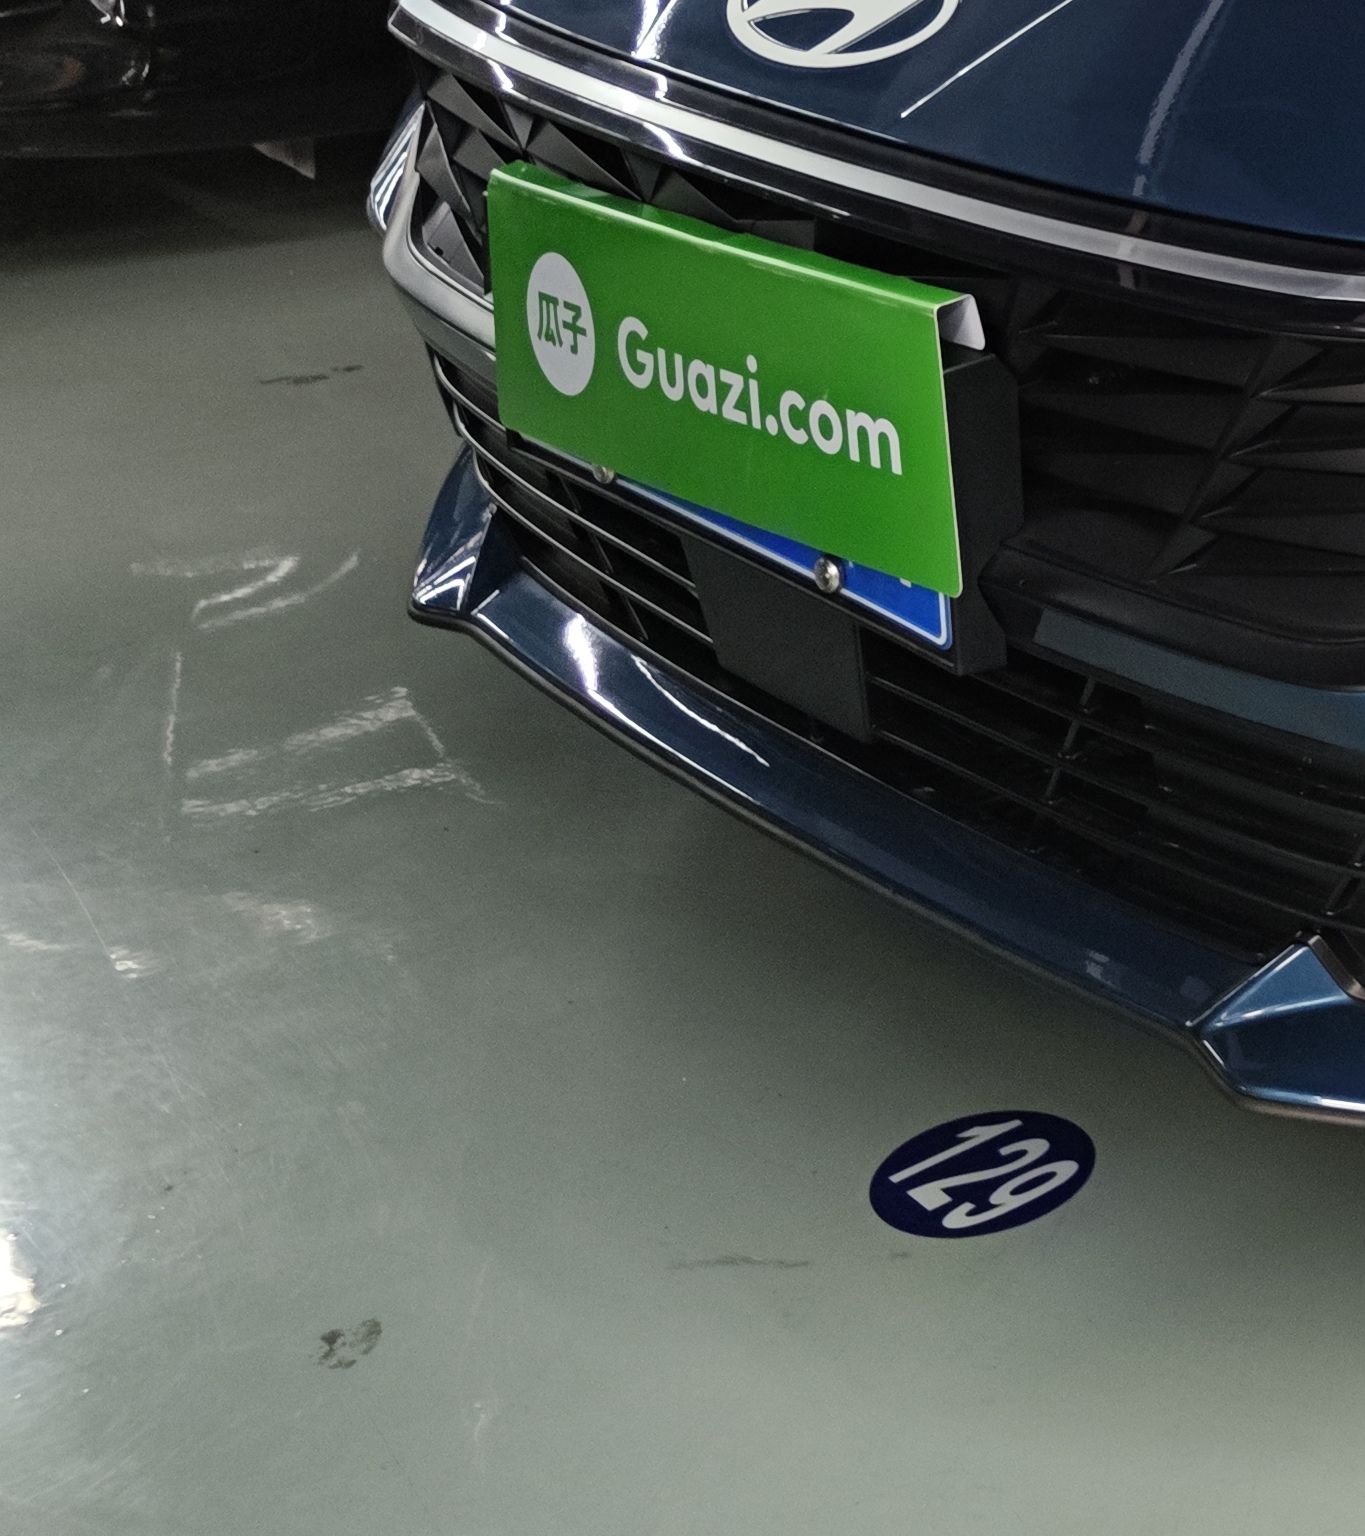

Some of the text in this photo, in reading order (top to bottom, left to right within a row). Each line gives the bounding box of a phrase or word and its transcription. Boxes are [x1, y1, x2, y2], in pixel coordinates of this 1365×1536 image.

[536, 290, 588, 356] 瓜子
[616, 315, 903, 476] Guazi.com
[888, 1118, 1080, 1230] 129
